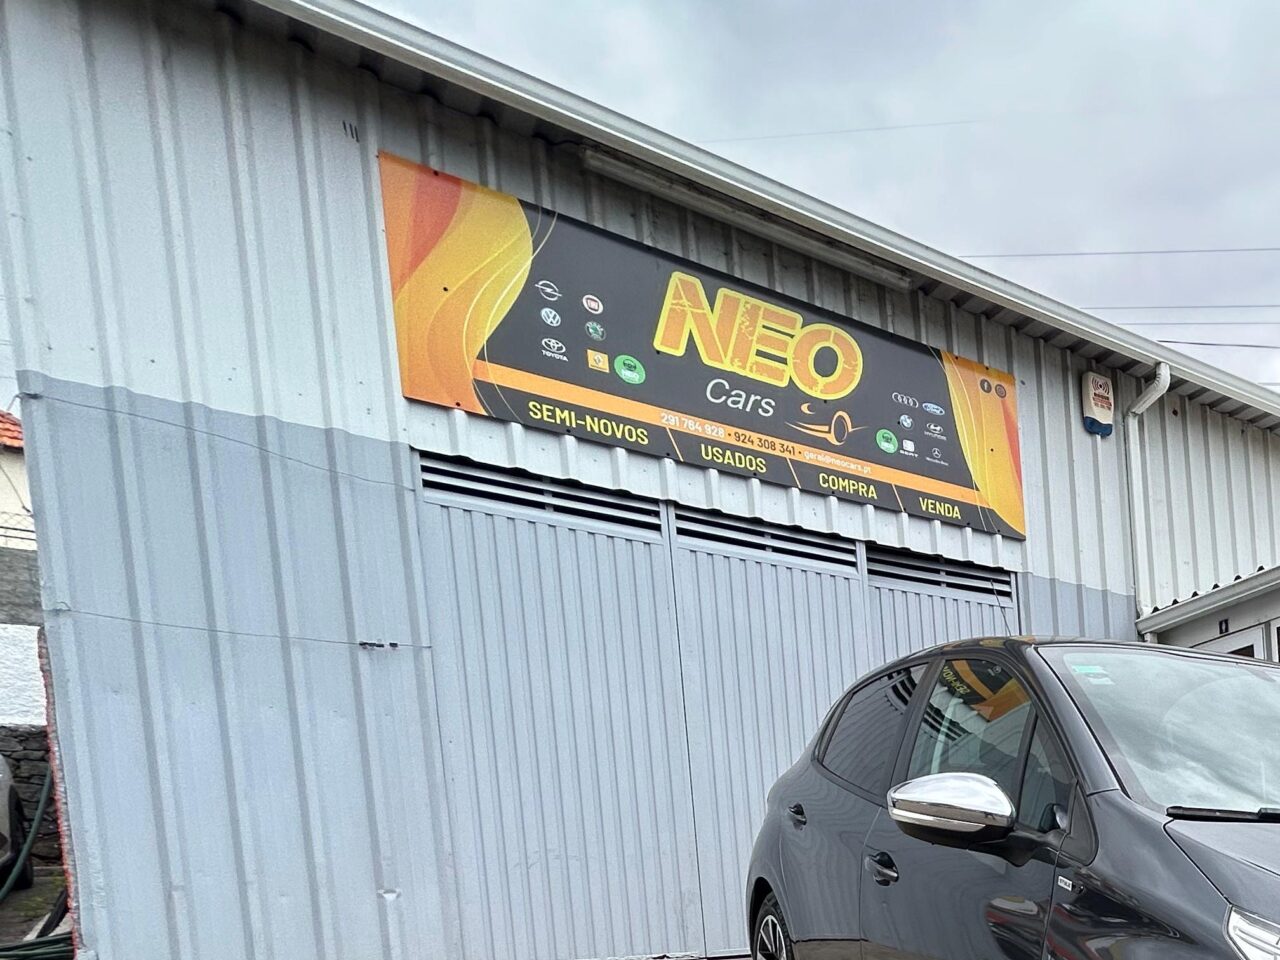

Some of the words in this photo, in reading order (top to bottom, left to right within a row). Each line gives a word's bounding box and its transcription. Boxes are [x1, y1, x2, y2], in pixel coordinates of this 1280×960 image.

[541, 349, 569, 361] TOYOTA
[653, 271, 864, 400] NEO
[706, 378, 776, 418] Cars
[661, 412, 680, 427] 291
[704, 424, 726, 439] 928
[734, 431, 755, 446] 924
[757, 437, 777, 452] 308
[779, 441, 796, 456] 341
[527, 400, 649, 445] SEMI-NOVOS
[700, 443, 767, 473] USADOS
[819, 472, 878, 500] COMPRA
[919, 496, 962, 520] VENDA
